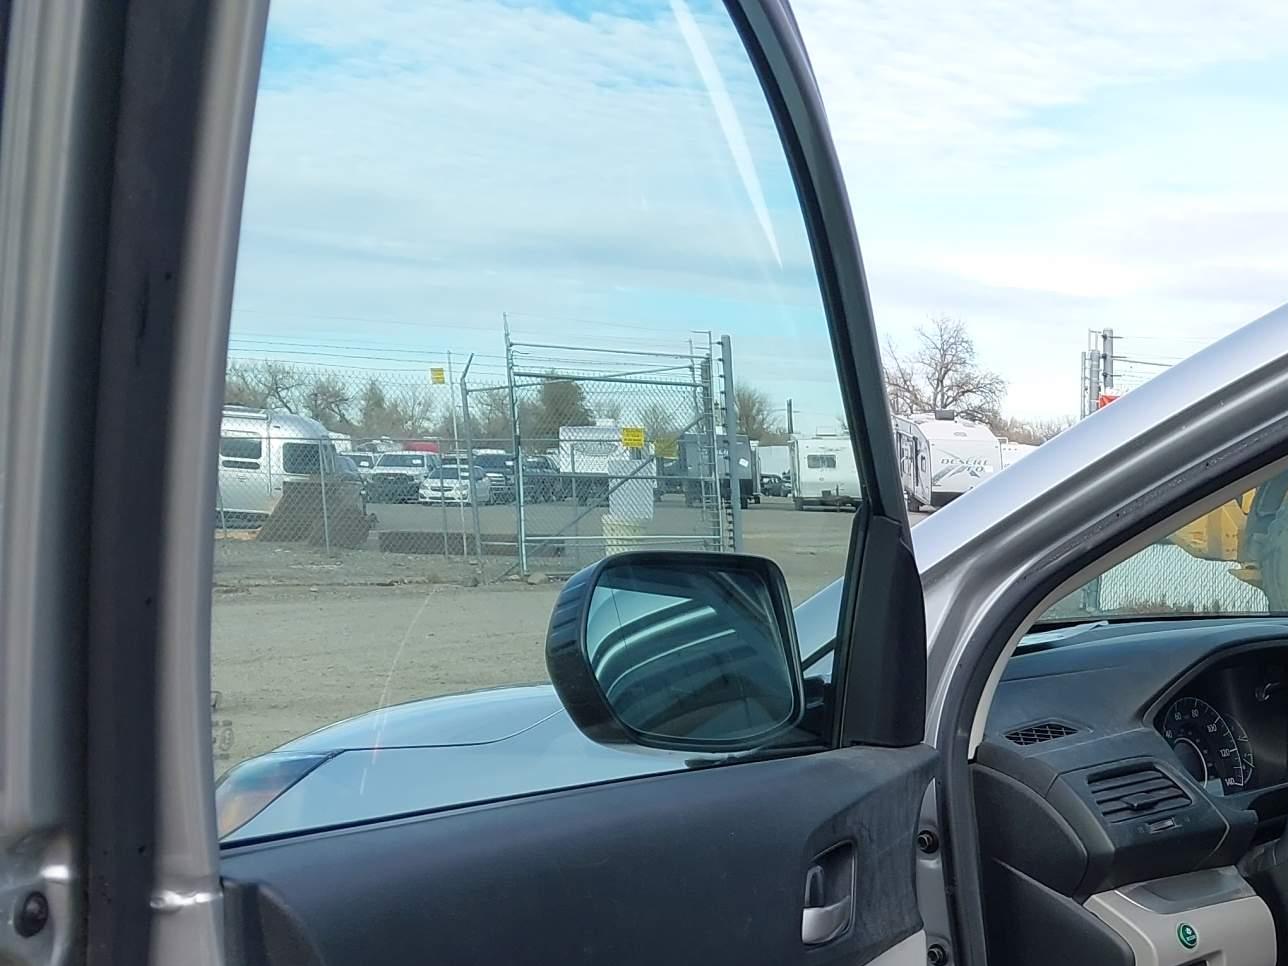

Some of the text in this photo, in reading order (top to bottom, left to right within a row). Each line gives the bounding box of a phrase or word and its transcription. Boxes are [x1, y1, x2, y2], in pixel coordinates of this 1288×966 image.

[1207, 723, 1217, 733] 100
[1220, 749, 1231, 757] 120
[1225, 778, 1236, 786] 140
